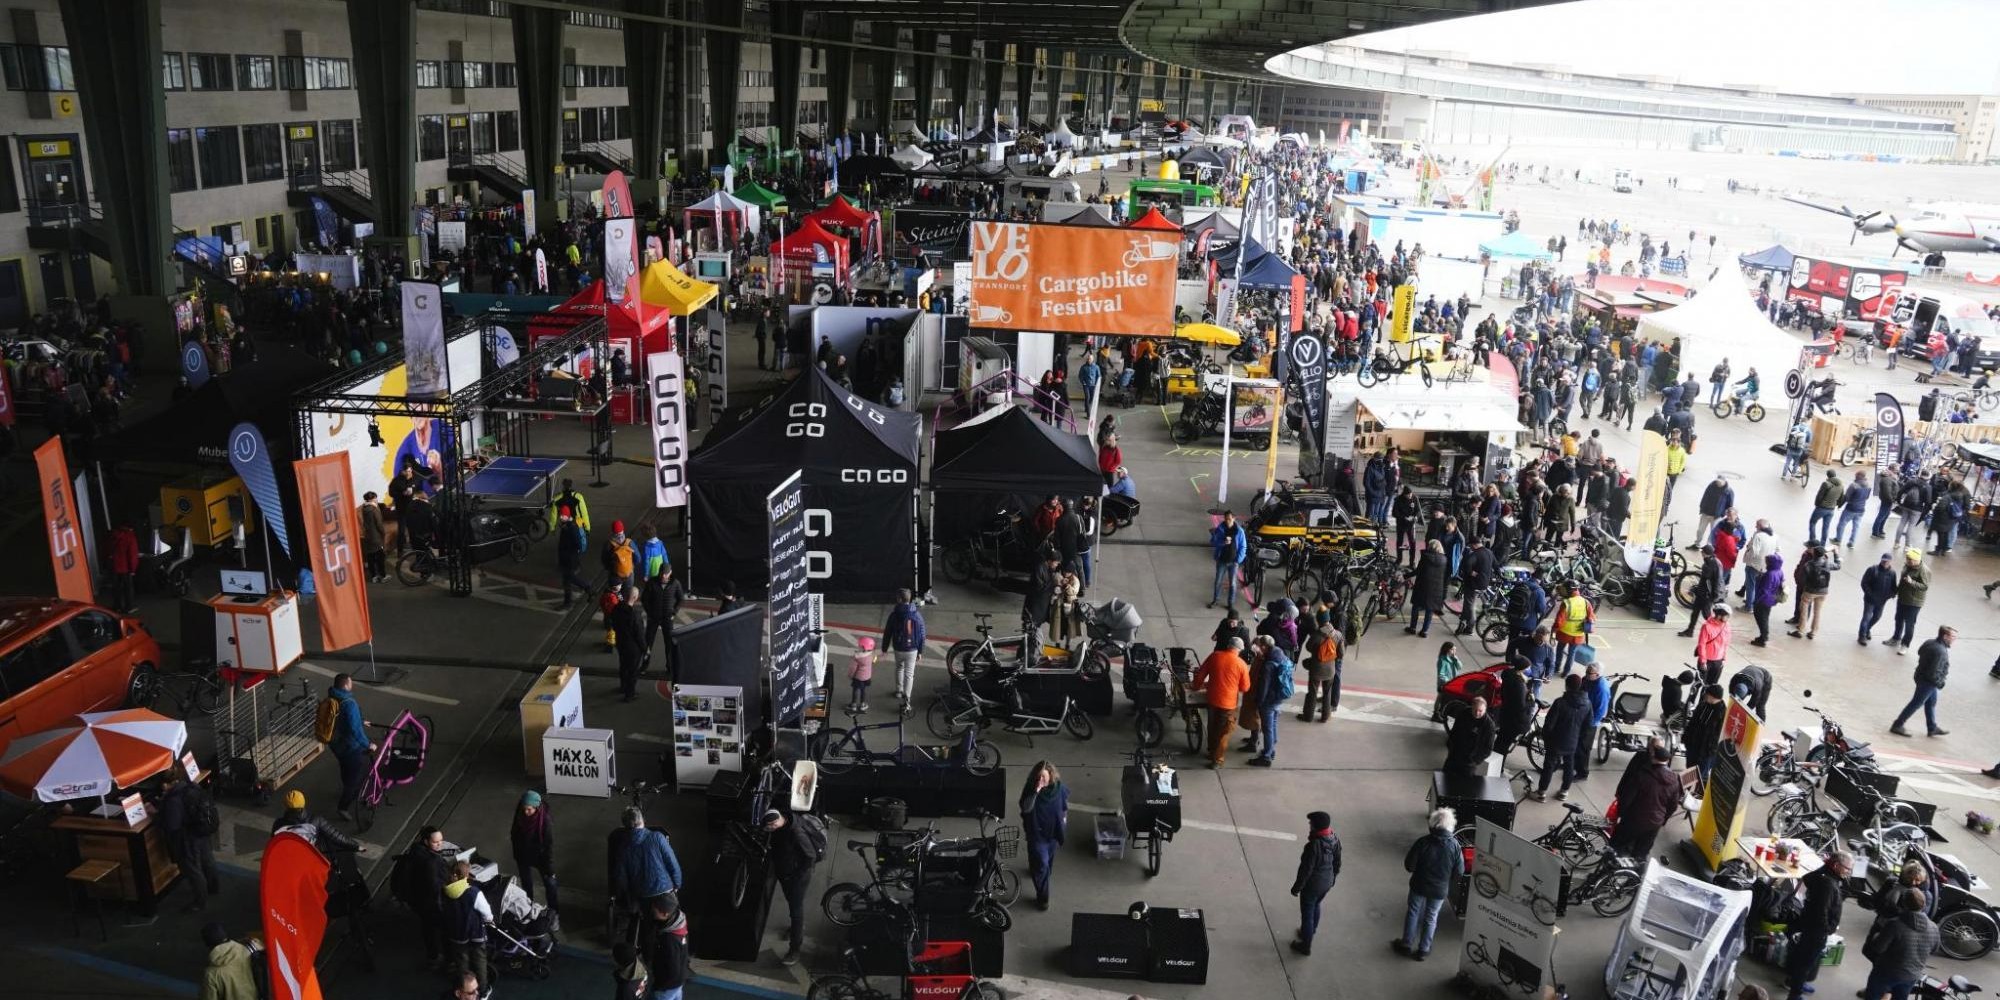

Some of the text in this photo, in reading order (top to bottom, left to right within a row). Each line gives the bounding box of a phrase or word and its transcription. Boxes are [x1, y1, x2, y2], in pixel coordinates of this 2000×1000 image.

[61, 99, 71, 113] C
[42, 144, 57, 153] GAT
[975, 223, 1030, 253] VE
[974, 250, 1029, 281] LO
[973, 282, 1028, 291] TRANSPORT
[1039, 270, 1148, 297] Cargobike
[569, 303, 604, 312] ergote
[1040, 295, 1122, 317] Festival
[198, 445, 229, 457] Mube
[584, 749, 597, 764] &
[53, 782, 98, 795] e2trail
